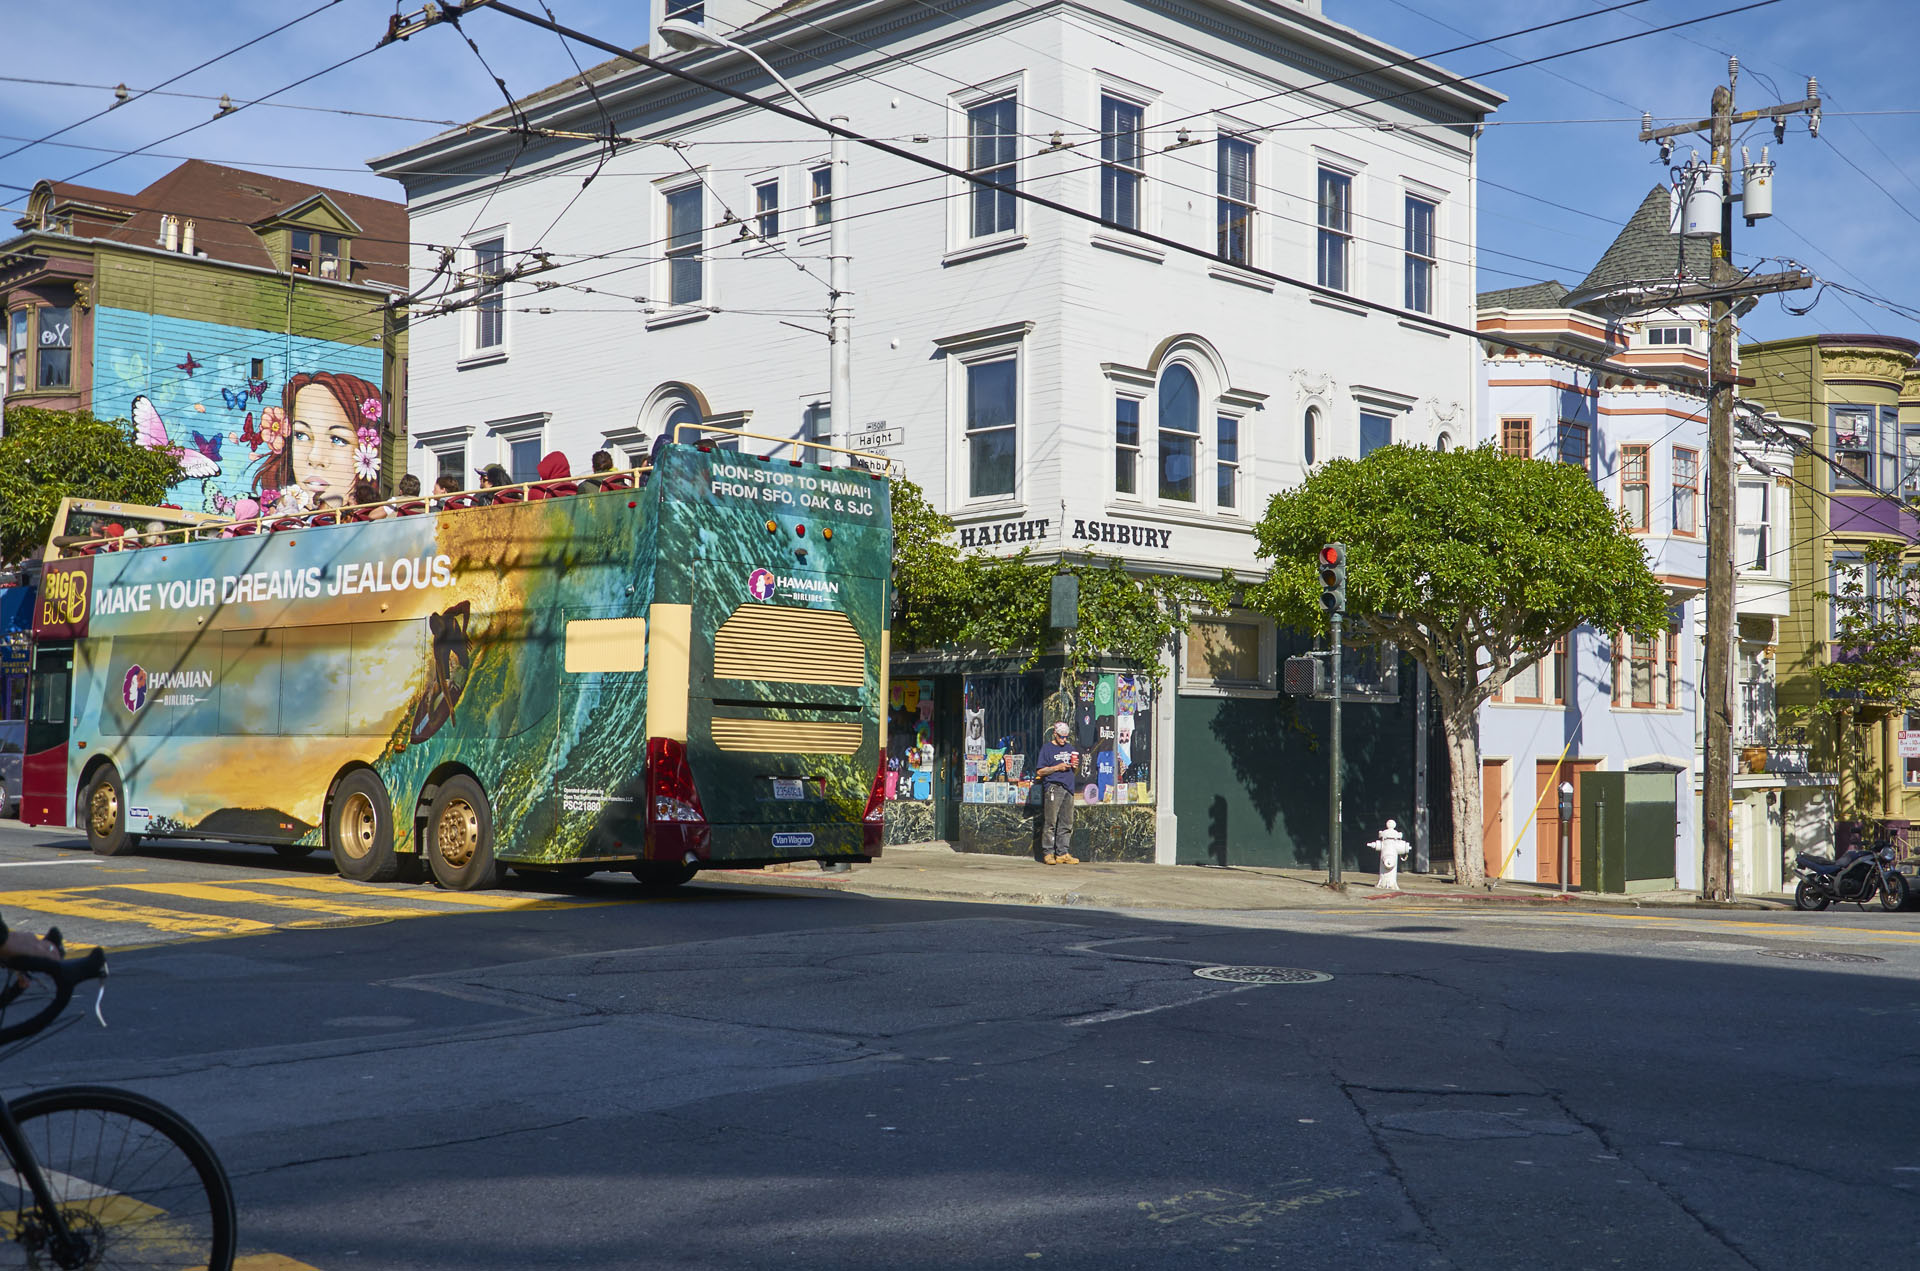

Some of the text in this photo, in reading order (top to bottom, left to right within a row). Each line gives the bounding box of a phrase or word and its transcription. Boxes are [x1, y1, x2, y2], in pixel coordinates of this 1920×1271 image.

[860, 432, 892, 447] Haight
[712, 463, 794, 487] NON-STOP
[797, 476, 817, 490] TO
[858, 459, 898, 474] Ashbuy
[711, 481, 873, 516] FROM SFO, OAK & SJC
[960, 518, 1050, 548] HAIGHT
[1072, 519, 1172, 549] ASHBURY
[45, 571, 70, 600] BIG
[95, 555, 457, 616] MAKE YOUR DREAMS JEALOUS.
[777, 576, 839, 594] HAWAIIAN
[793, 592, 824, 603] AIRLINES
[43, 600, 67, 625] BUS
[149, 670, 213, 689] HAWAIIAN
[164, 694, 195, 706] AIRLINES
[788, 836, 811, 846] Wagner
